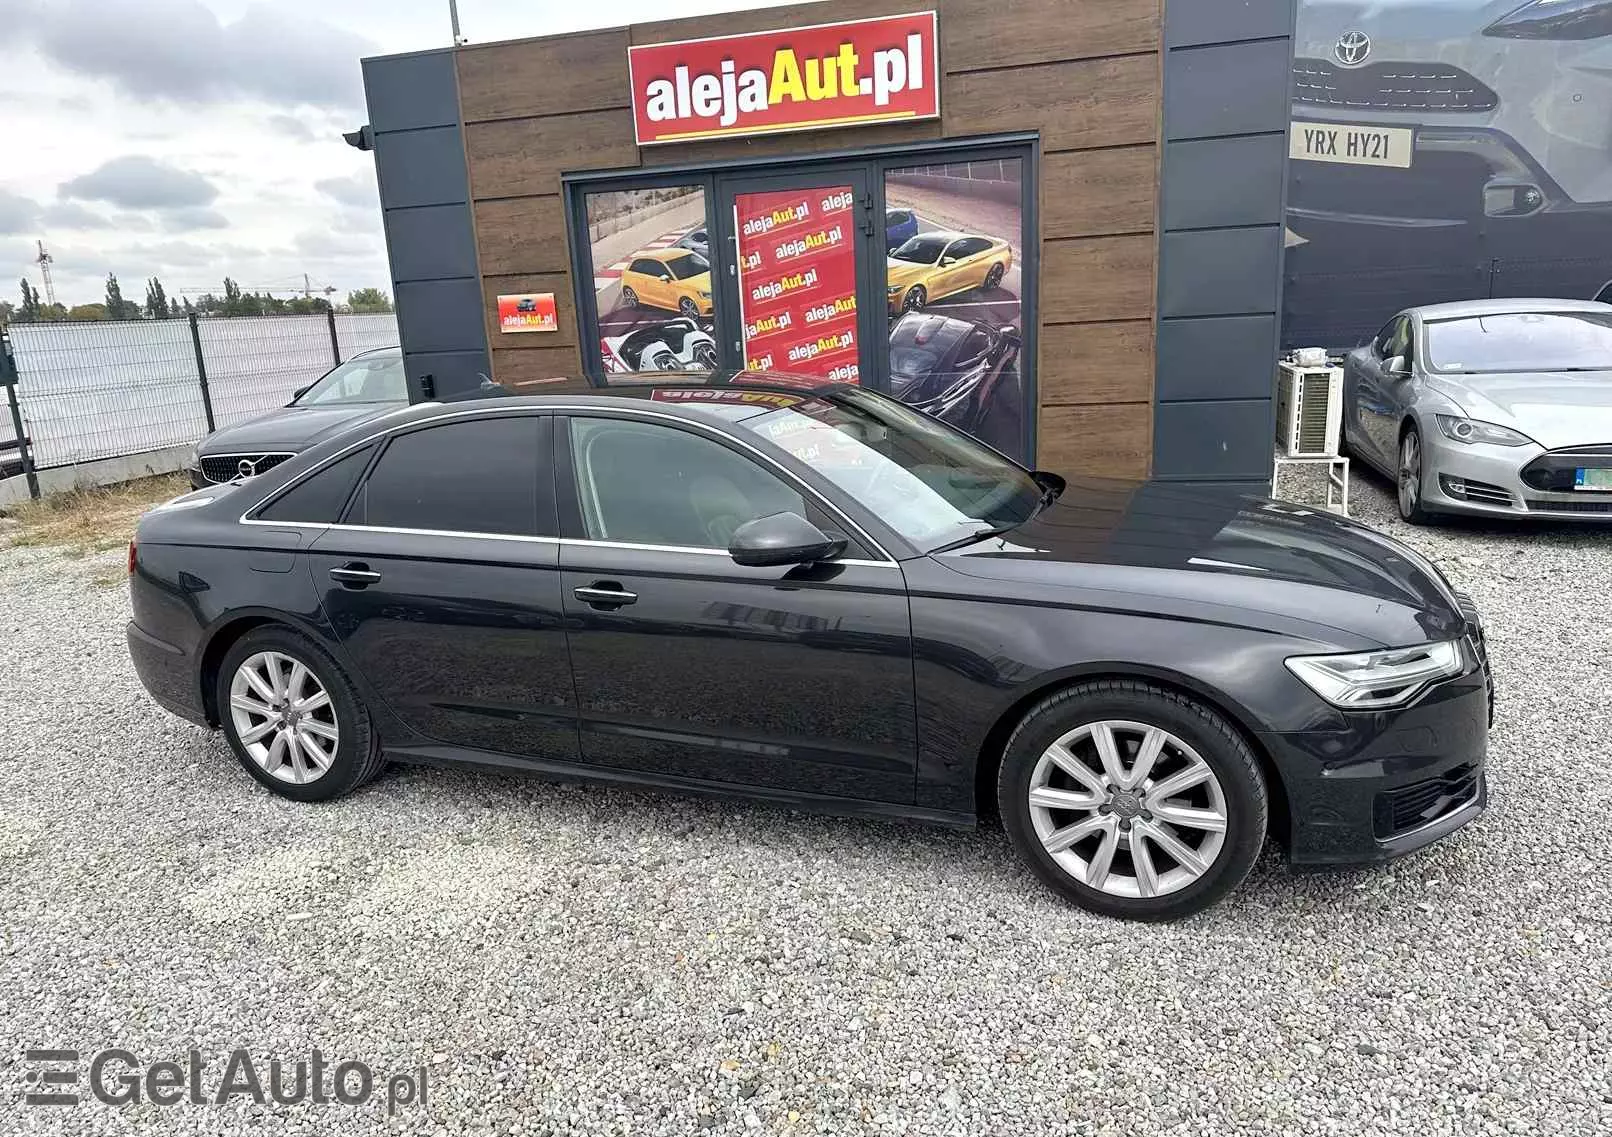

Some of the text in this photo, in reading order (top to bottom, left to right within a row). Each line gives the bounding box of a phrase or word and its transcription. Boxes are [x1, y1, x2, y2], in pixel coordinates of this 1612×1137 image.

[646, 33, 922, 127] alejaAut.pl
[1304, 129, 1389, 159] YRX HY21
[743, 202, 809, 236] alejaAut.pl
[775, 226, 842, 259] alejaAut.pl
[752, 269, 818, 300] alejaAut.pl
[503, 313, 553, 327] alejaAut.pl
[788, 331, 854, 361] alejaAut.pl
